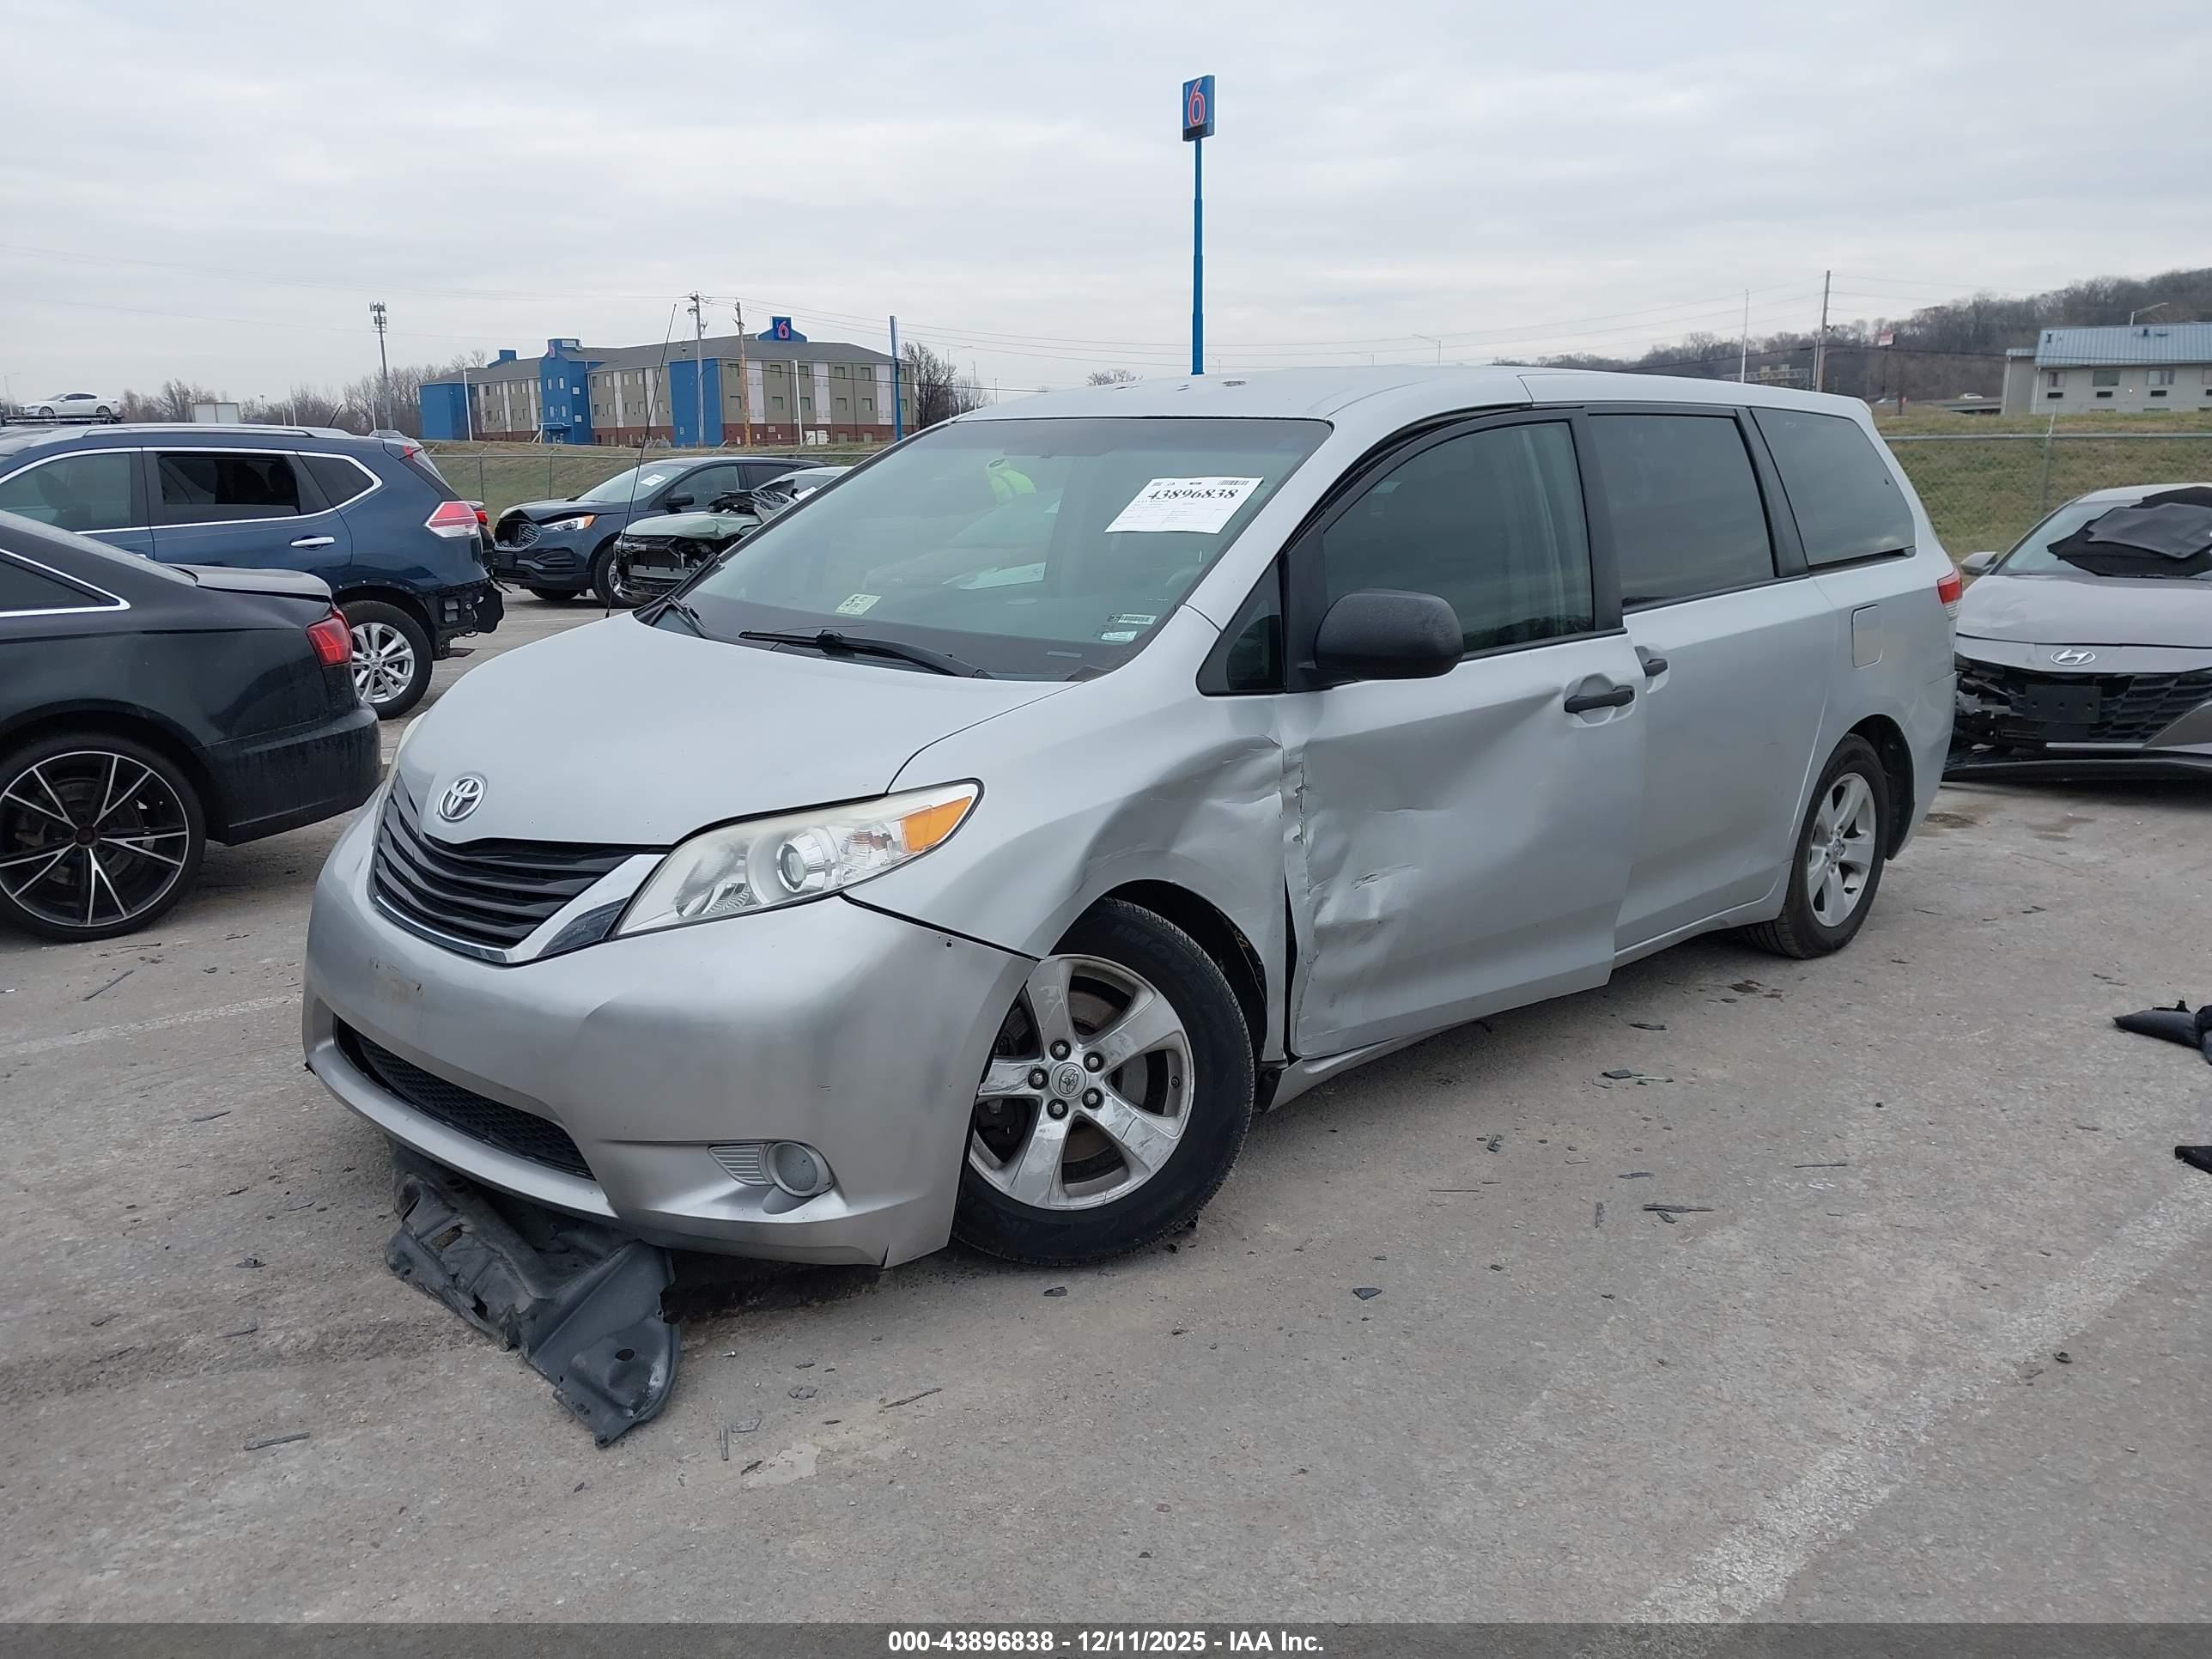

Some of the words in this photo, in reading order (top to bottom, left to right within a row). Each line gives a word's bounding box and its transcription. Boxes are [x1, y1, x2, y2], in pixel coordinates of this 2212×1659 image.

[1188, 79, 1206, 126] 6
[778, 321, 789, 338] 6
[1147, 489, 1238, 500] 43896838
